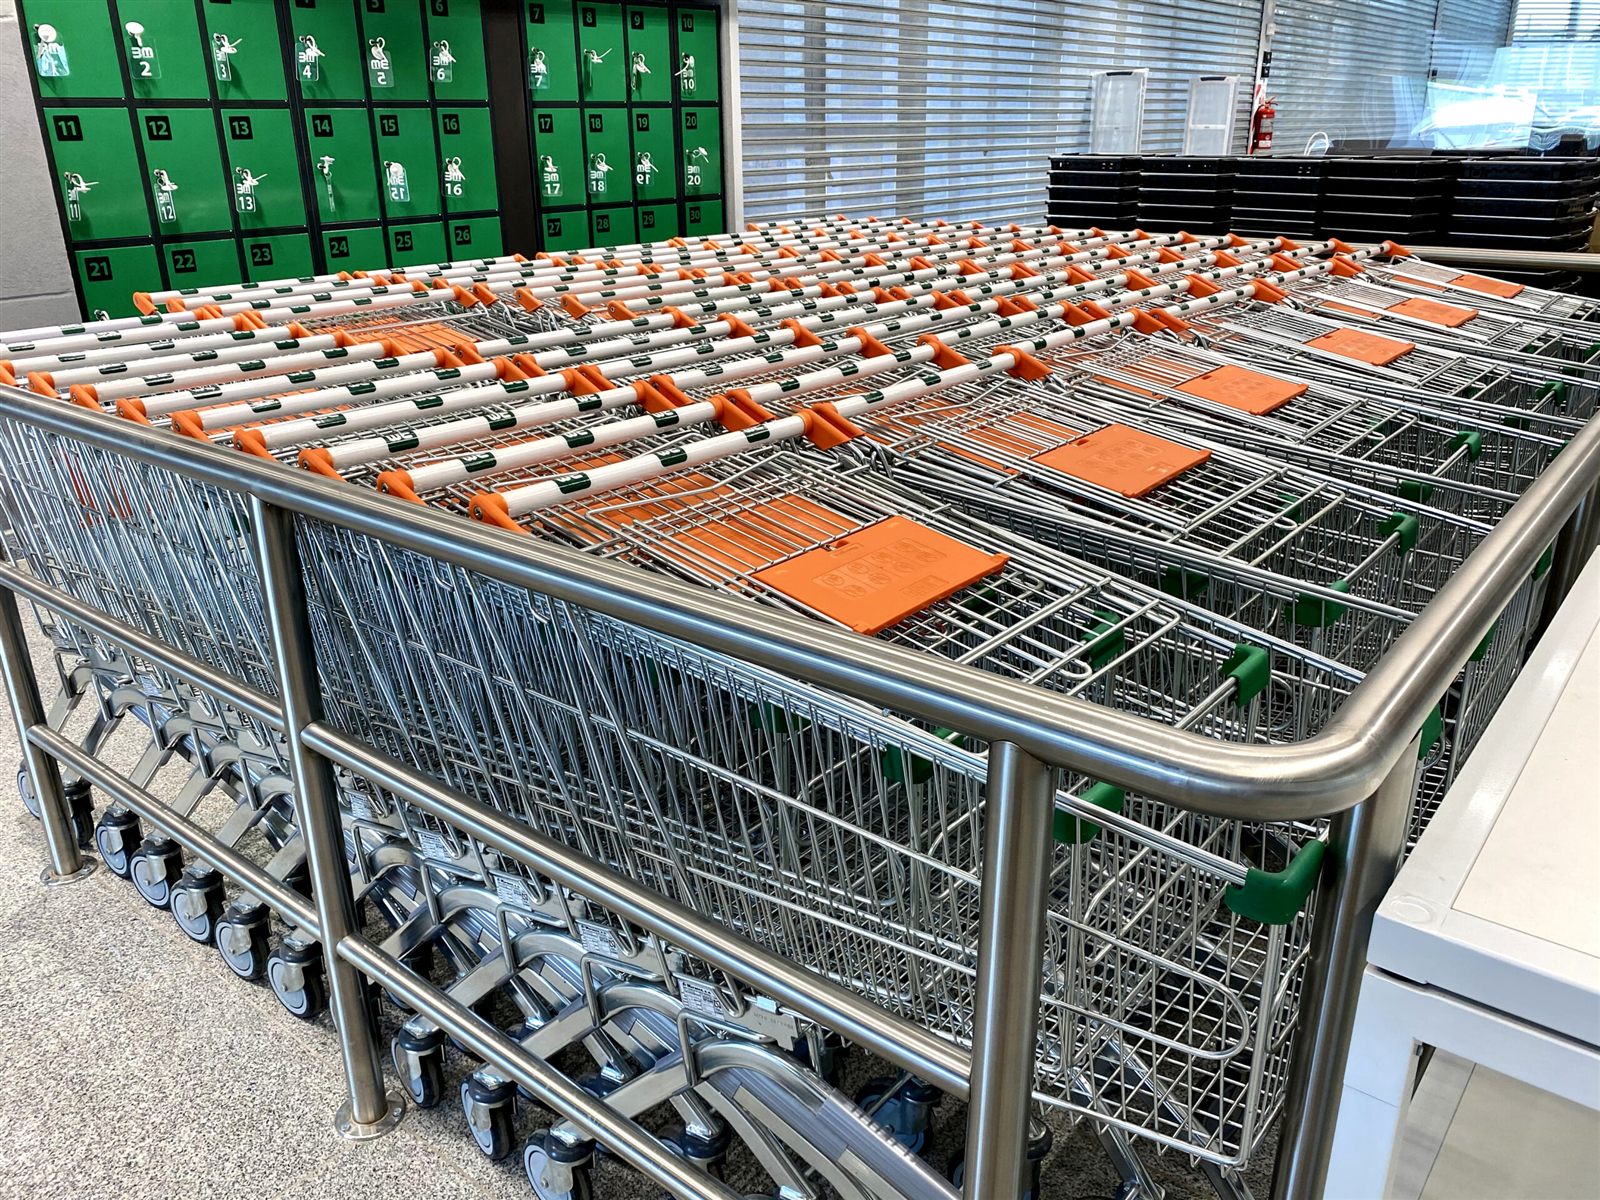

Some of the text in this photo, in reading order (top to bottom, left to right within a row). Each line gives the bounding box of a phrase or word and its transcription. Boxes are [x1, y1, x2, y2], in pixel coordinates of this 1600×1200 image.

[435, 0, 444, 12] 6
[533, 8, 540, 19] 7
[586, 12, 593, 23] 8
[634, 15, 641, 25] 9
[683, 18, 692, 28] 10
[139, 61, 152, 77] 2
[221, 64, 227, 78] 3
[303, 65, 311, 78] 4
[437, 68, 445, 80] 6
[534, 76, 543, 87] 7
[683, 79, 695, 90] 10
[315, 120, 330, 132] 14
[382, 120, 396, 132] 15
[444, 119, 457, 130] 16
[540, 118, 551, 129] 17
[591, 118, 601, 129] 18
[638, 117, 648, 128] 19
[686, 116, 696, 126] 20
[58, 121, 77, 136] 11
[149, 121, 169, 136] 12
[232, 121, 250, 135] 13
[687, 175, 701, 185] 20
[445, 184, 462, 195] 16
[545, 184, 560, 195] 17
[591, 181, 605, 192] 18
[239, 197, 253, 210] 13
[70, 204, 78, 219] 11
[162, 206, 174, 220] 12
[690, 210, 700, 220] 30
[597, 219, 609, 229] 28
[643, 215, 654, 225] 29
[548, 223, 560, 233] 27
[456, 230, 470, 241] 26
[397, 236, 411, 247] 25
[331, 241, 348, 254] 24
[253, 248, 271, 262] 23
[174, 255, 194, 268] 22
[90, 262, 108, 276] 21
